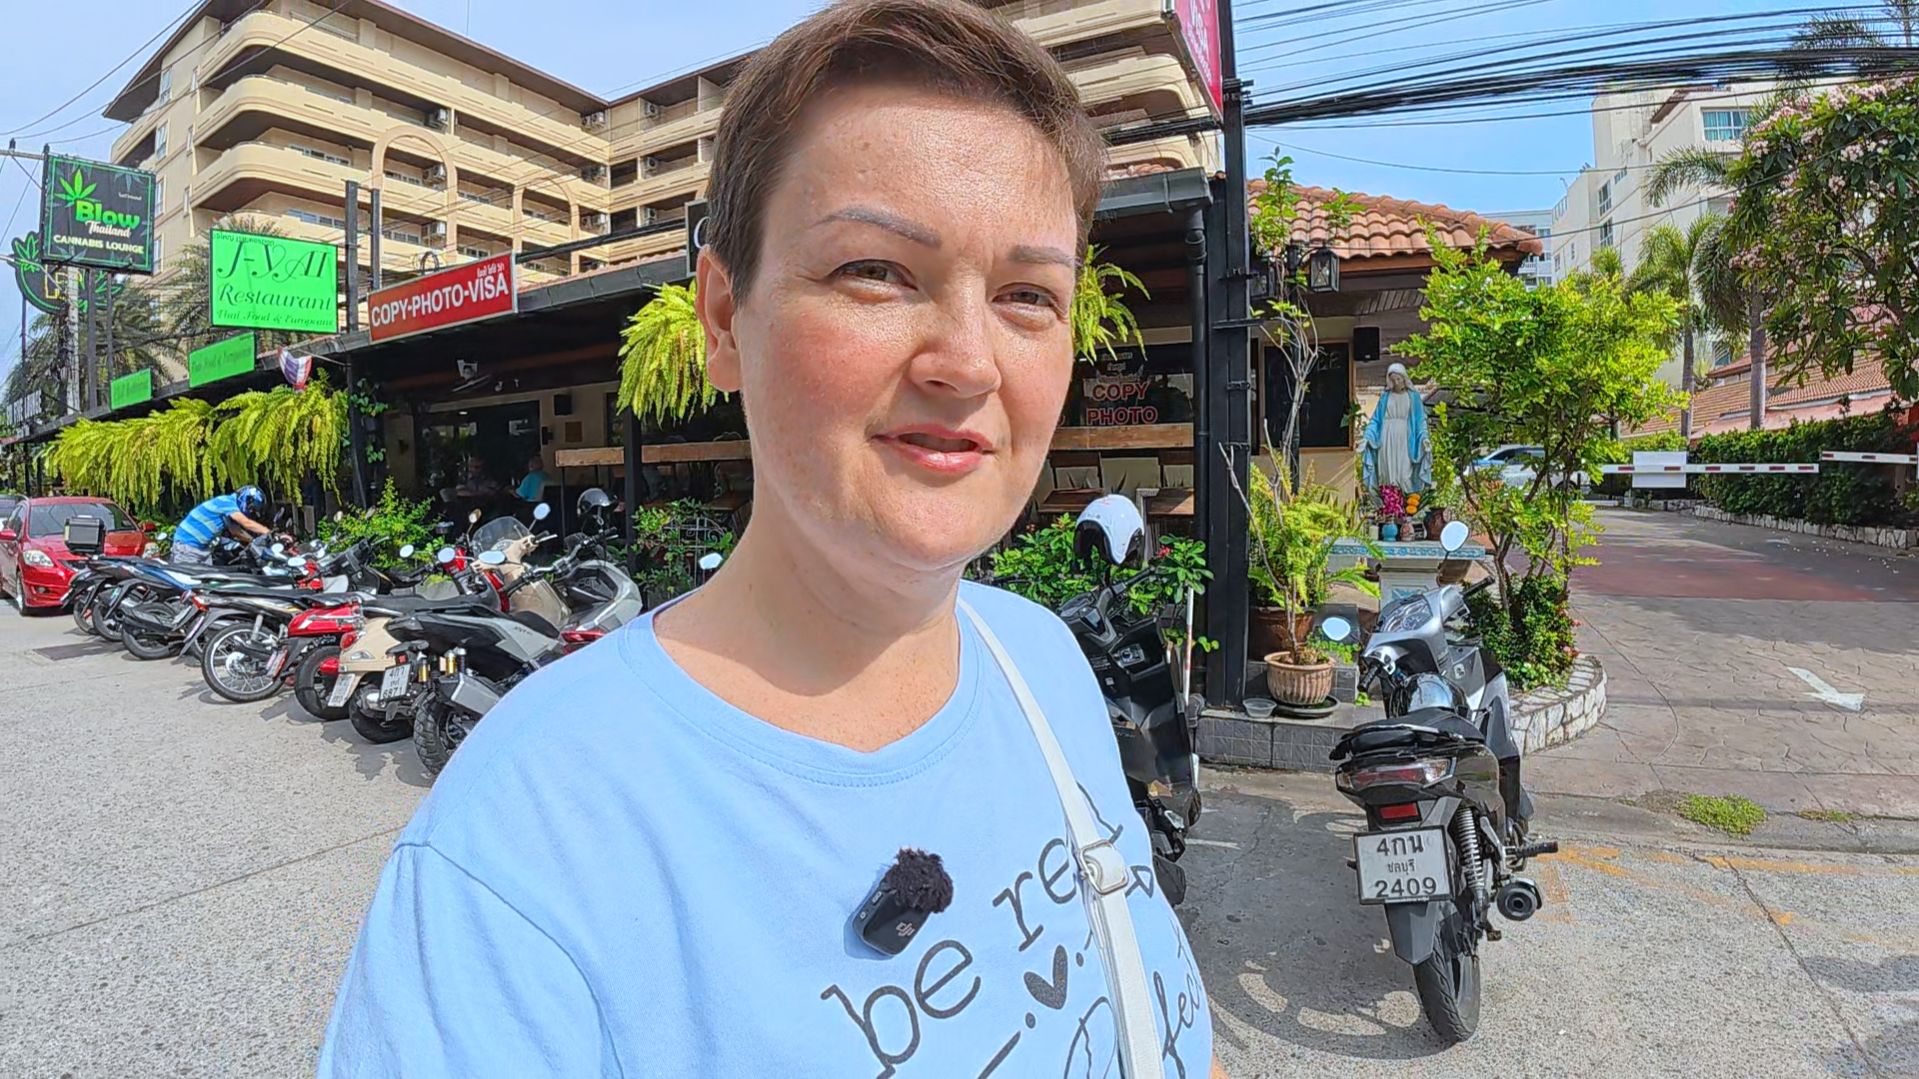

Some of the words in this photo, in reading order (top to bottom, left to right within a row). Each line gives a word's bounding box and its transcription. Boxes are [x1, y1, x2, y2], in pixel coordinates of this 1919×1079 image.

[75, 200, 140, 230] Blow
[85, 220, 132, 238] Thailand
[53, 234, 103, 249] CANNABIS
[106, 241, 144, 254] LOUNGE
[218, 283, 331, 311] Restaurant
[1092, 381, 1150, 401] COPY
[1086, 406, 1158, 425] PHOTO
[1376, 834, 1424, 856] 4กน
[1387, 858, 1416, 876] ชลบุรี
[1375, 877, 1437, 898] 2409
[820, 939, 981, 1079] be
